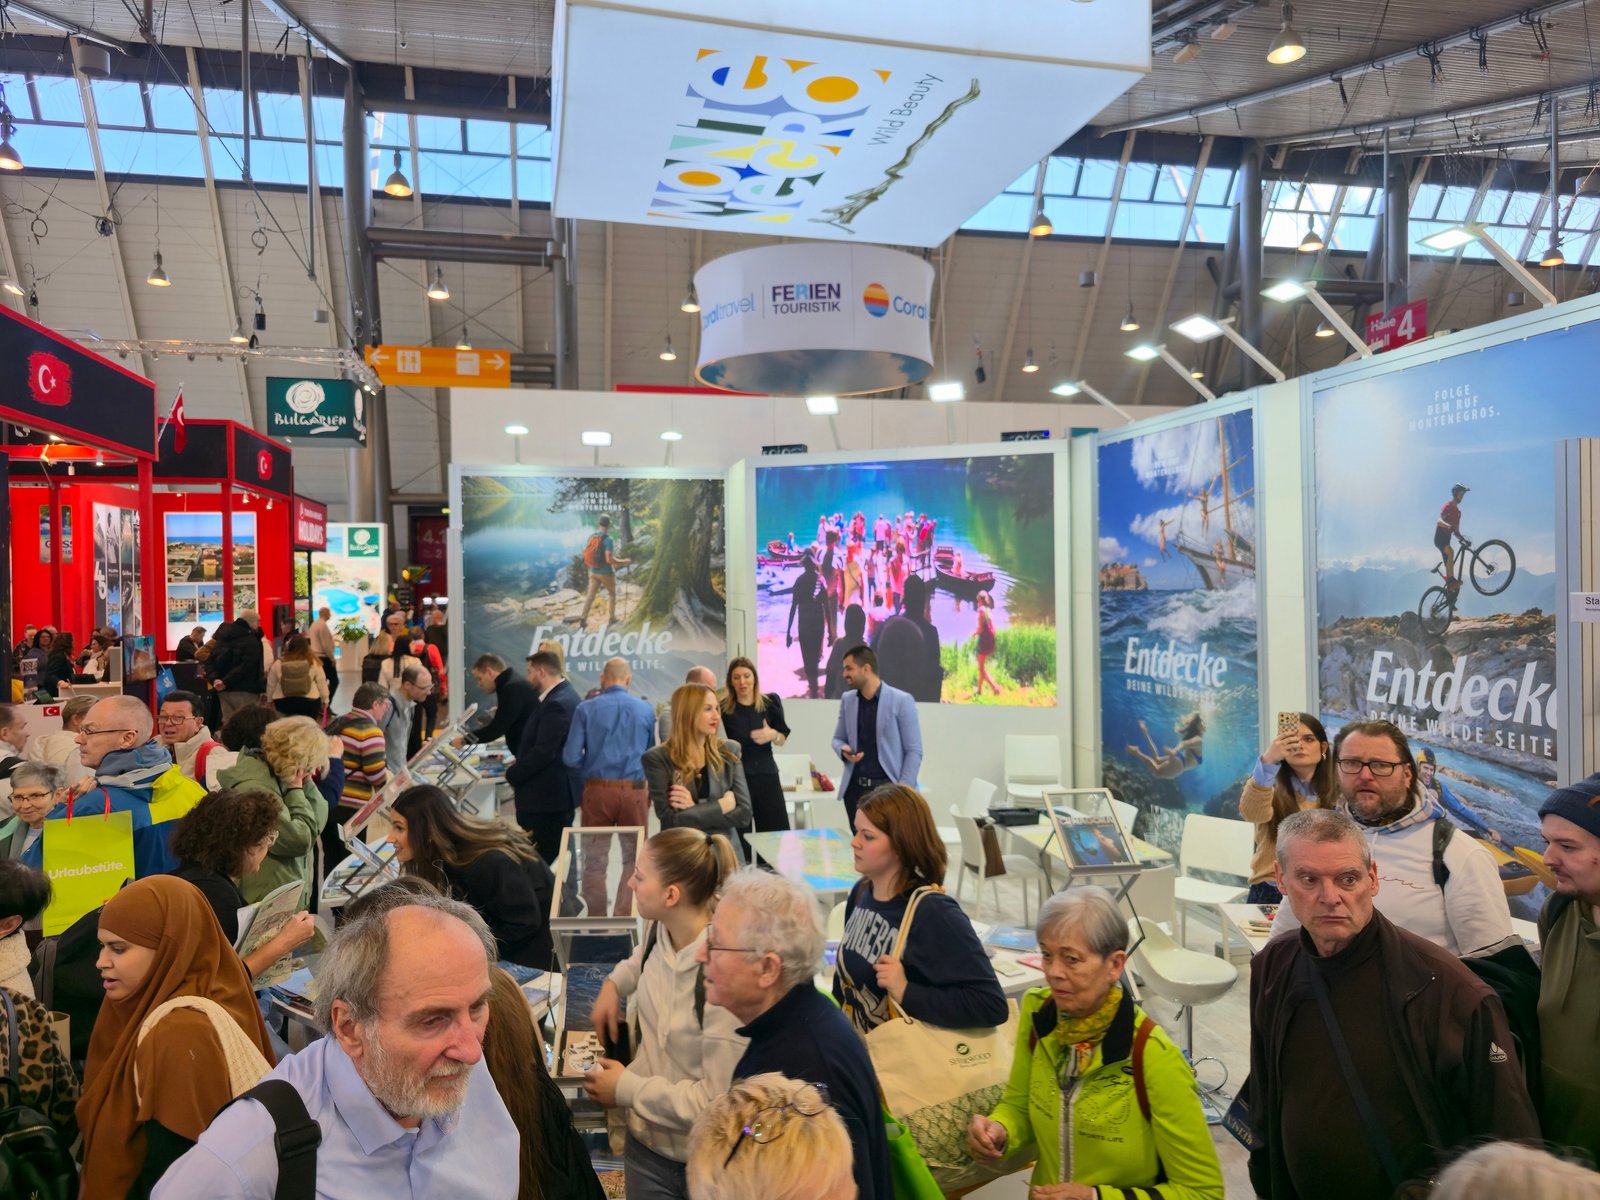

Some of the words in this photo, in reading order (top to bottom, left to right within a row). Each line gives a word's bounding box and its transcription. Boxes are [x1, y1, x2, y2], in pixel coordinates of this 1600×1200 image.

[867, 116, 904, 147] Wild
[889, 72, 944, 118] Beauty
[771, 283, 841, 303] FERIEN
[772, 302, 841, 316] TOURISTIK
[1397, 309, 1416, 340] 4
[1434, 384, 1470, 402] FOLGE
[1427, 400, 1450, 416] DEM
[1456, 395, 1479, 410] RUF
[1408, 404, 1500, 432] MONTENEGROS.
[528, 621, 673, 658] Entdecke
[632, 659, 665, 670] EITE.
[1124, 636, 1228, 688] Entdecke
[1126, 678, 1152, 694] DEINE
[1426, 718, 1484, 744] WILDE
[1495, 730, 1552, 757] SEITE
[48, 861, 126, 880] Urlaubstüte.
